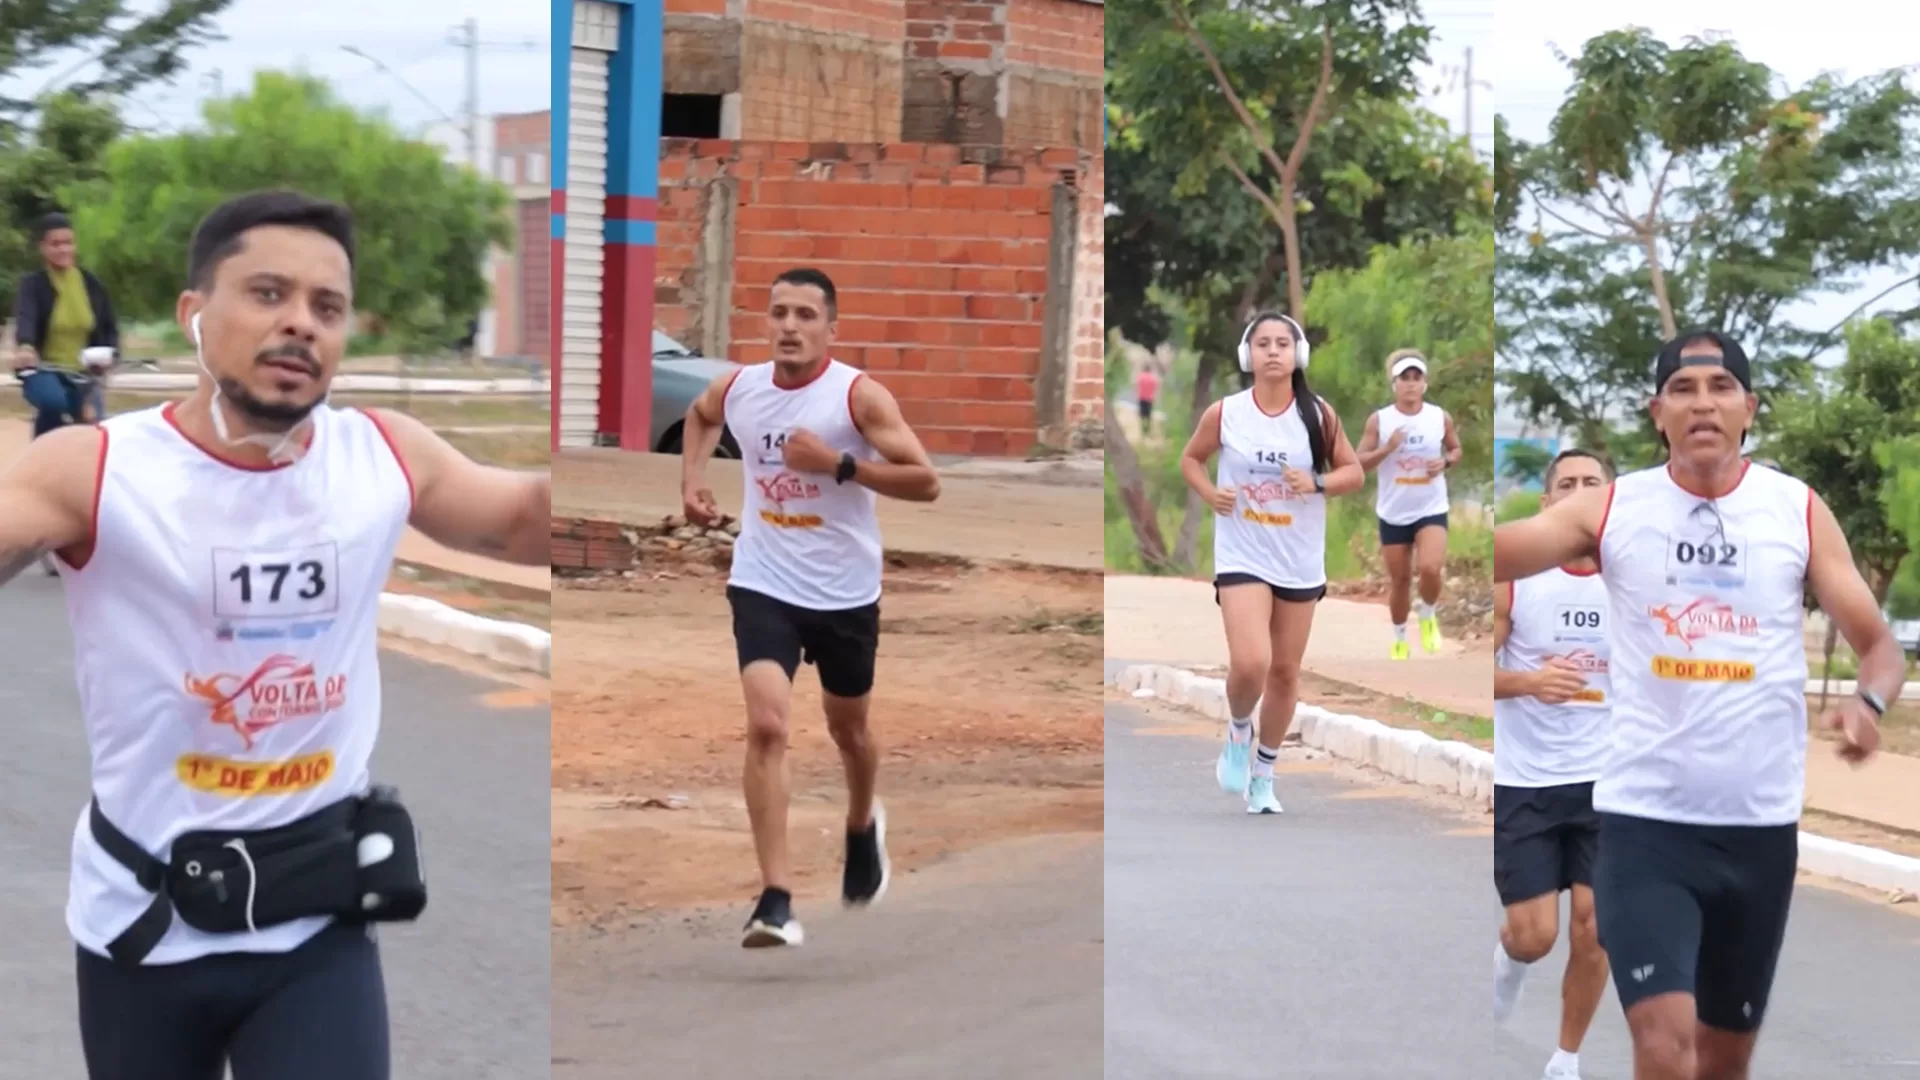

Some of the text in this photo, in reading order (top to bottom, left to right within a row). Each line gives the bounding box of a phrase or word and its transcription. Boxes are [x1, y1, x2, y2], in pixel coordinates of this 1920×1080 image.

[762, 433, 786, 450] 14
[1256, 450, 1288, 464] 145
[1676, 541, 1738, 567] 092
[230, 560, 326, 604] 173
[1562, 610, 1600, 628] 109
[1687, 611, 1735, 631] VOLTA
[1739, 615, 1758, 629] DA
[1675, 661, 1697, 677] DE
[249, 681, 318, 704] VOLTA
[219, 766, 256, 789] DE
[266, 757, 330, 787] MAIO
